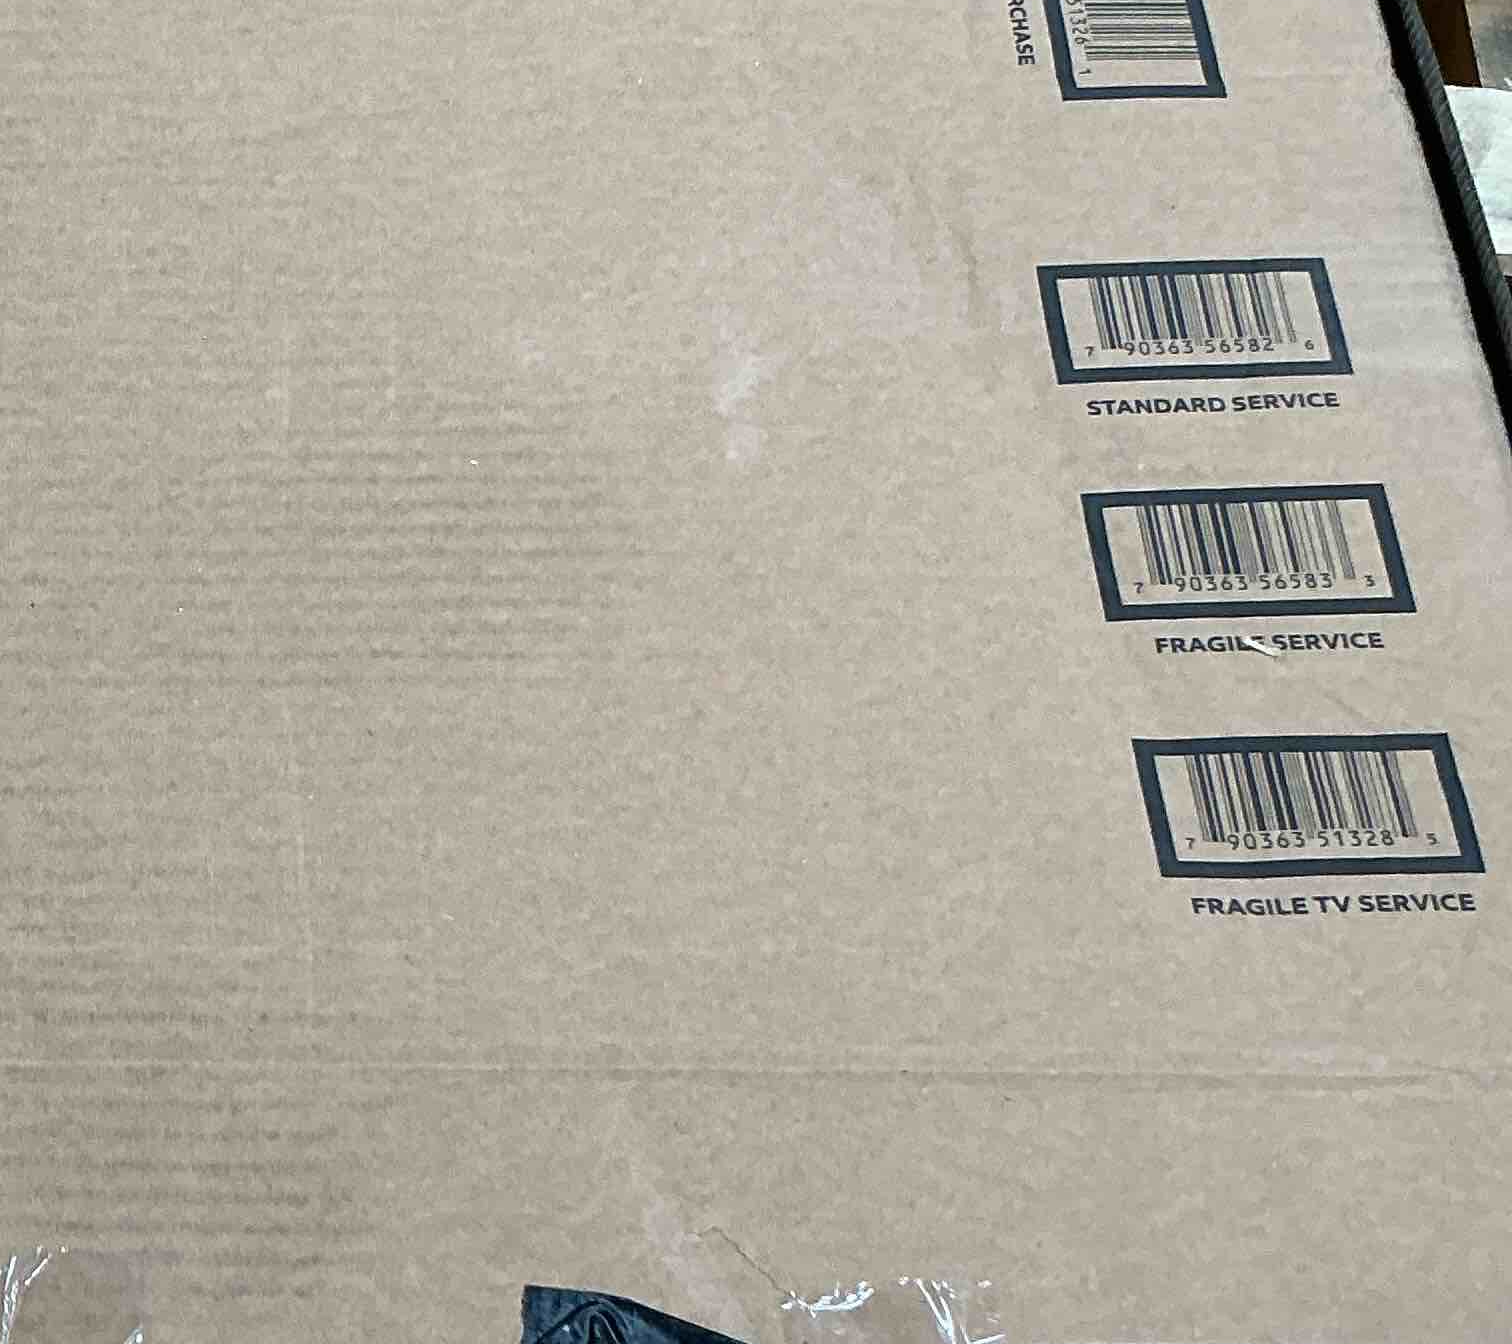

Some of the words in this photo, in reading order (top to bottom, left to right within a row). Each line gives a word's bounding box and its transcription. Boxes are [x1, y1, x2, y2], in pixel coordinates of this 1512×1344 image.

[1125, 339, 1194, 357] 90363
[1205, 337, 1275, 354] 56582
[1087, 397, 1226, 417] STANDARD
[1232, 392, 1340, 413] SERVICE
[1174, 575, 1249, 593] 90363
[1259, 572, 1333, 591] 56583
[1272, 632, 1385, 651] SERVICE
[1227, 831, 1306, 850] 90363
[1317, 829, 1395, 848] 51328
[1190, 897, 1309, 916] FRAGILE
[1313, 895, 1351, 914] TV
[1358, 892, 1477, 913] SERVICE
